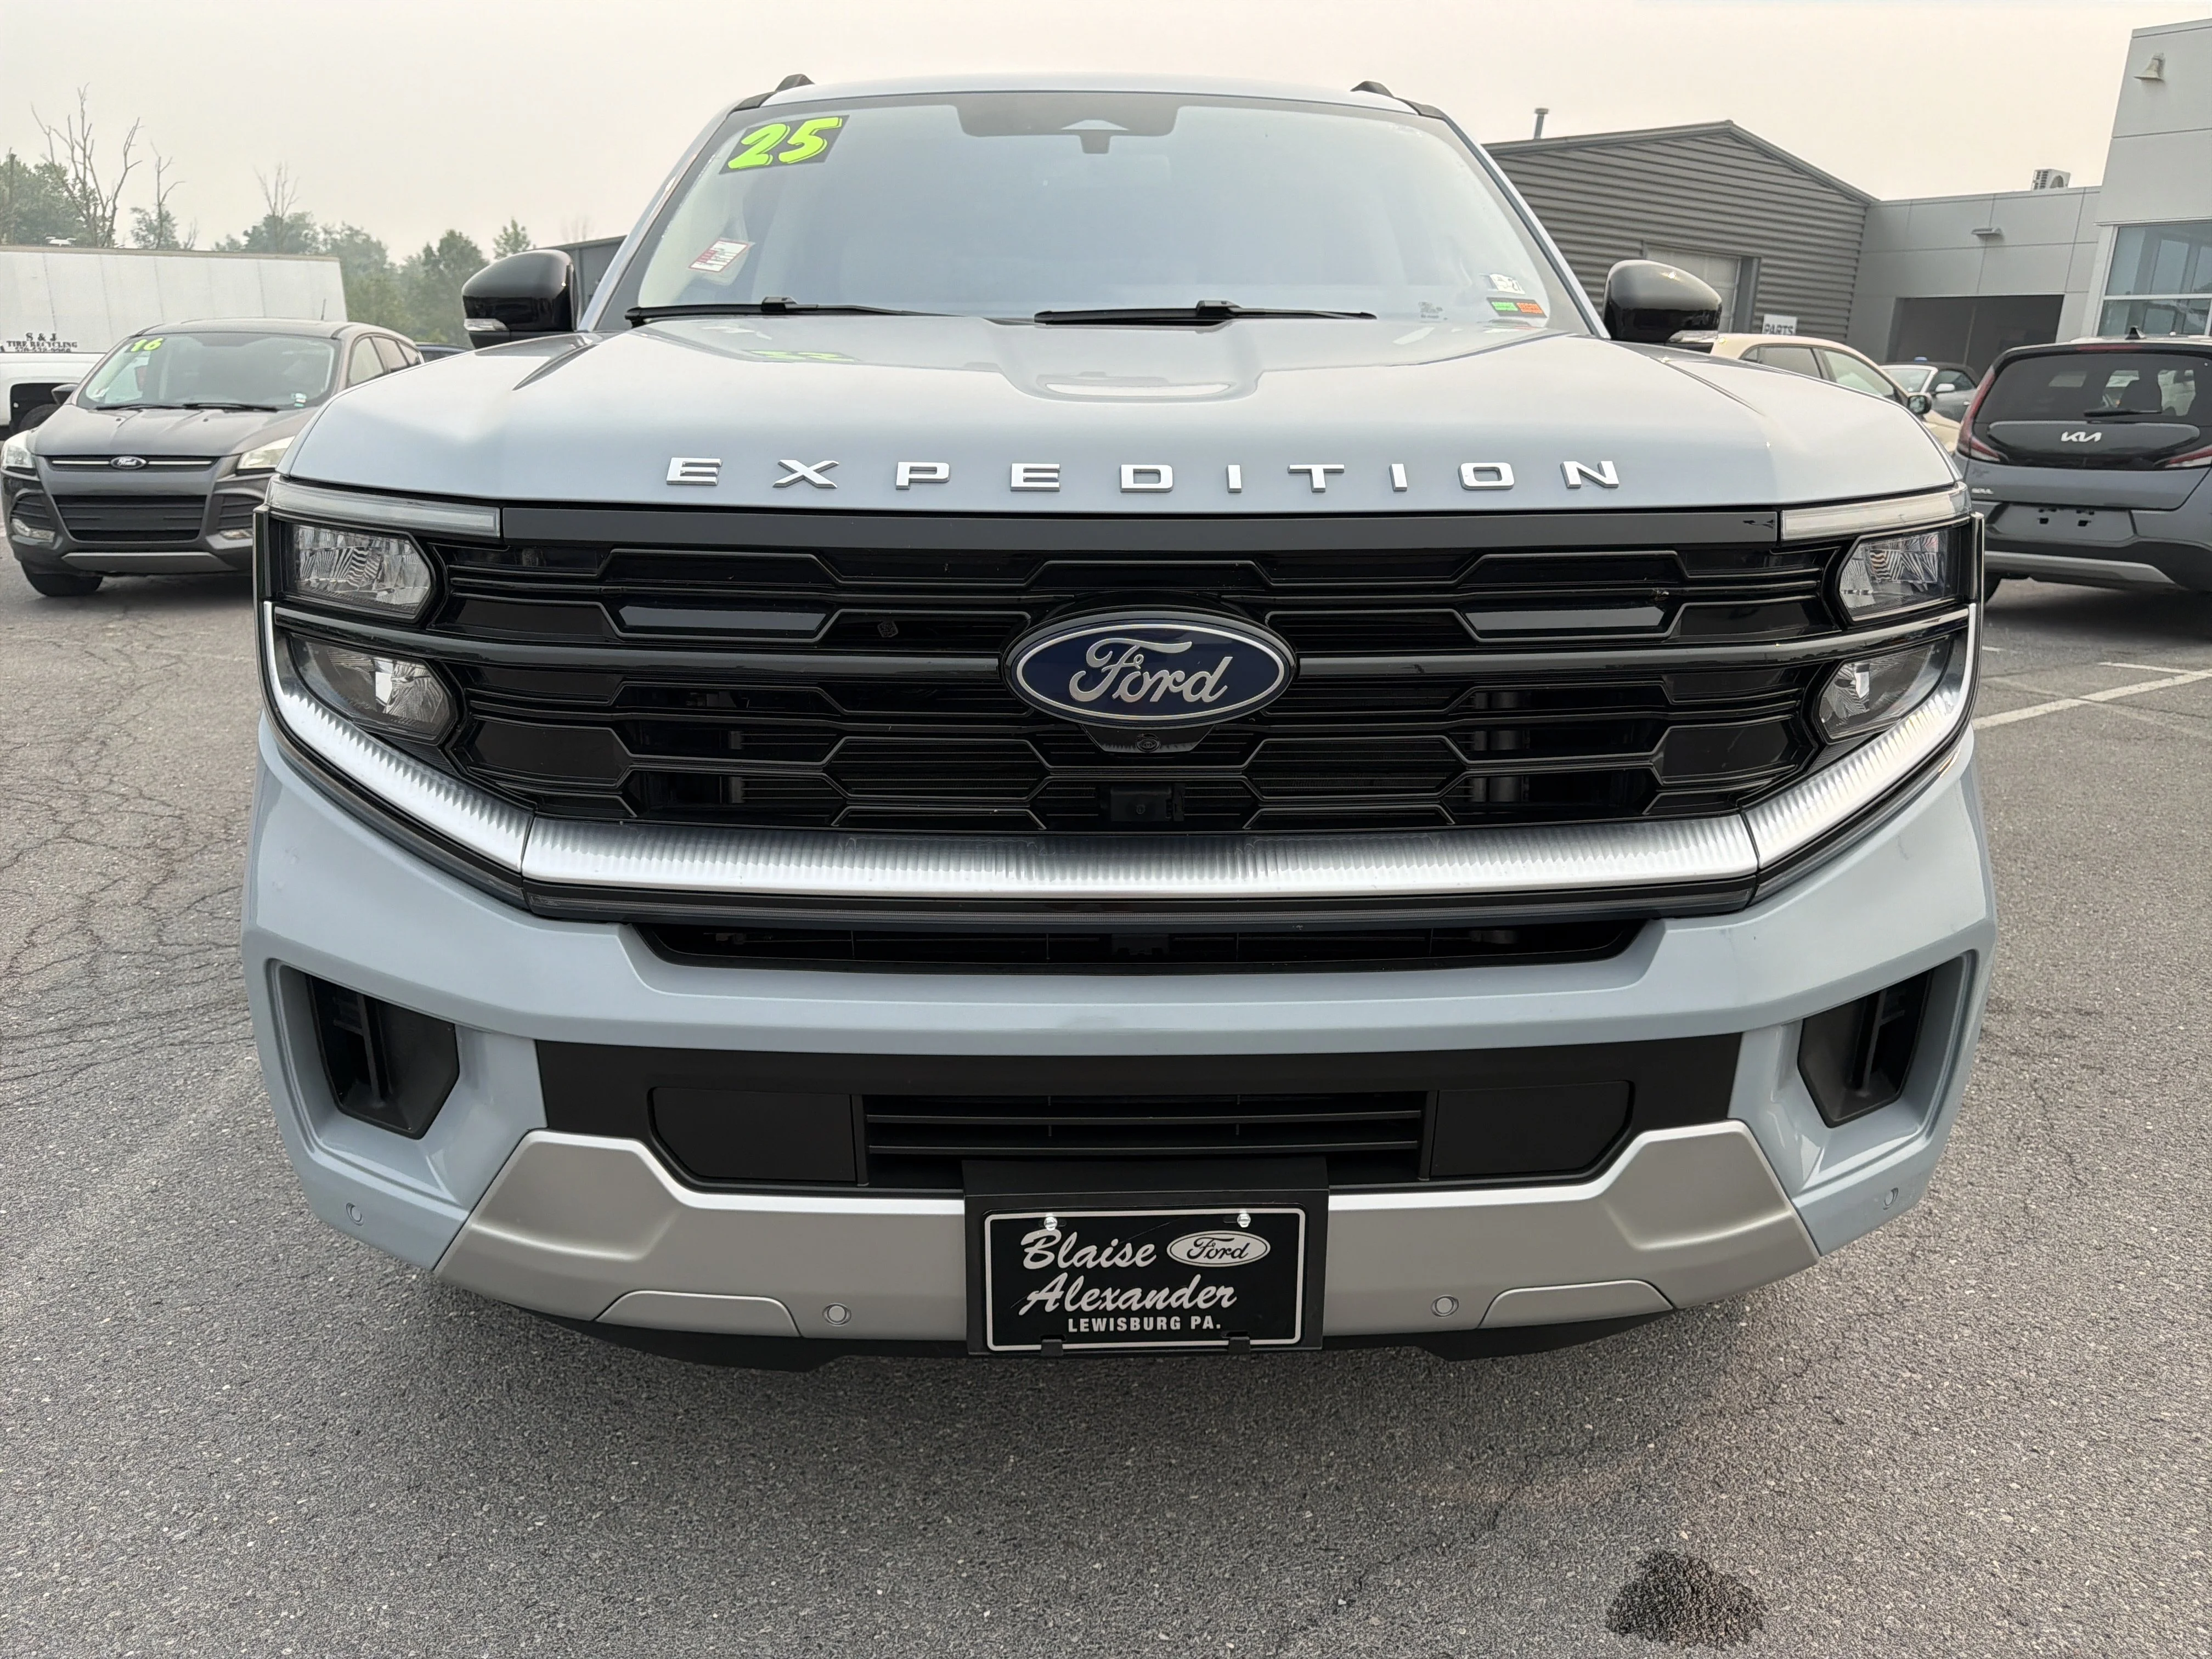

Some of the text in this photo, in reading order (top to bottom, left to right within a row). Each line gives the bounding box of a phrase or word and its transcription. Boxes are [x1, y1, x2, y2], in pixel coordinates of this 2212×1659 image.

[728, 116, 843, 170] 25
[25, 332, 33, 341] S
[38, 332, 46, 341] &
[131, 337, 164, 352] 16
[1764, 323, 1794, 335] PARTS
[666, 456, 1620, 493] EXPEDITION
[1069, 637, 1233, 703] Ford
[1020, 1229, 1249, 1269] Blaise Ford
[1018, 1272, 1238, 1316] Alexander
[1068, 1314, 1221, 1333] LEWISBURG PA.
